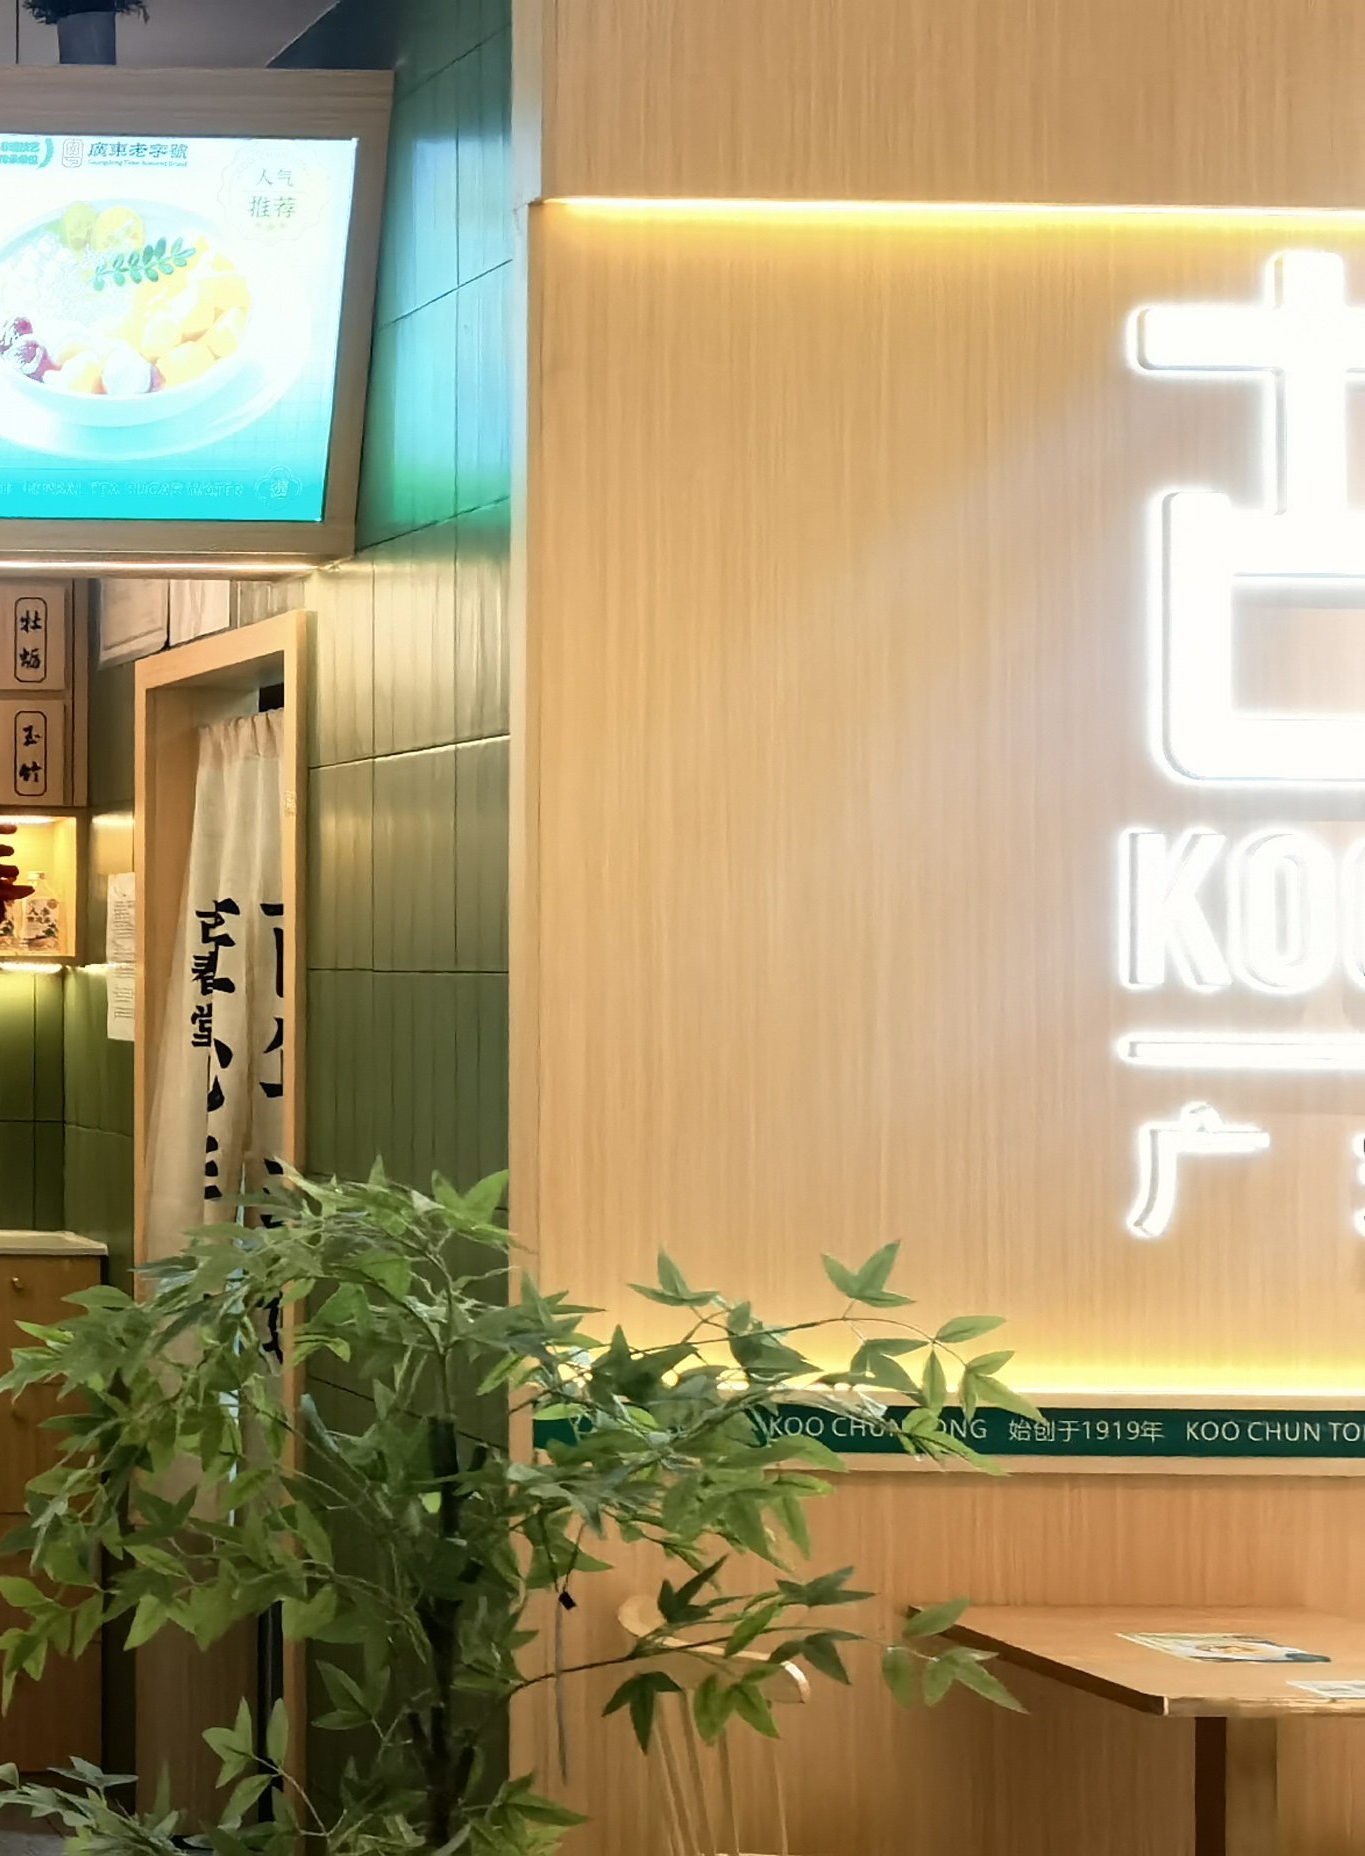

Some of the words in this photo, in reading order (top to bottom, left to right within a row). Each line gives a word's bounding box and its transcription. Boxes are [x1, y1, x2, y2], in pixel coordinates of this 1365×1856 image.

[256, 168, 293, 187] 人气
[249, 196, 296, 218] 推荐
[1127, 248, 1365, 788] 古
[19, 612, 41, 670] 牡蛎
[19, 725, 42, 784] 玉竹
[1117, 825, 1365, 994] KO
[1127, 1100, 1365, 1238] 广
[770, 1416, 825, 1438] KOO
[1008, 1419, 1166, 1447] 始创于1919年
[1186, 1421, 1240, 1443] KOO
[1247, 1422, 1321, 1444] CHUN
[1327, 1423, 1365, 1444] TO
